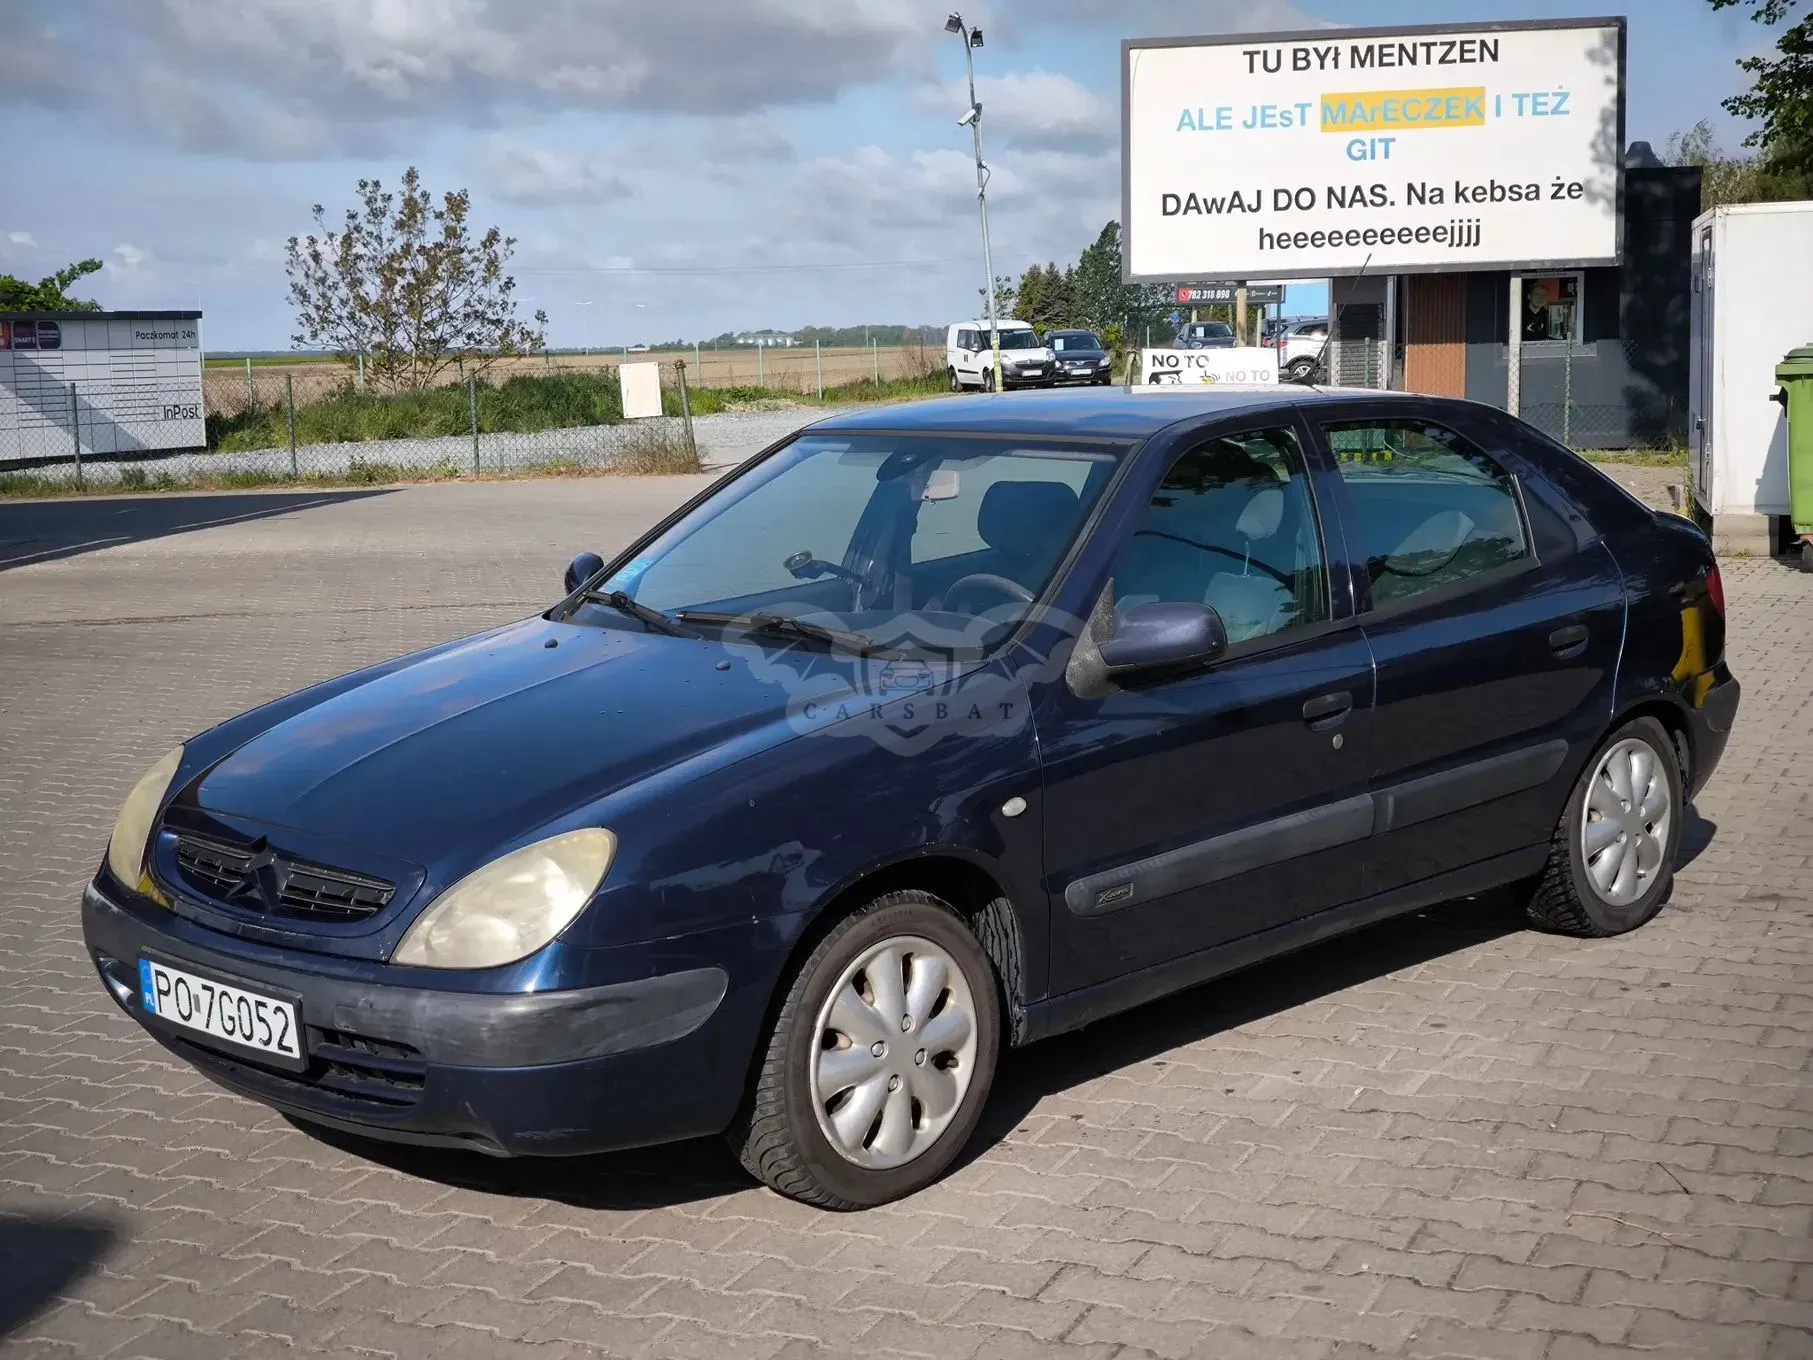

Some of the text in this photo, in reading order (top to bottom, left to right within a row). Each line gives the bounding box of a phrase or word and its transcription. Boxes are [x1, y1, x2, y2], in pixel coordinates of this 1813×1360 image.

[1242, 38, 1499, 74] TU BYł MENTZEN
[1176, 85, 1570, 132] ALE JEsT MArECZEK I TEŻ
[1346, 137, 1397, 162] GIT
[1161, 175, 1584, 217] DAwAJ DO NAS. Na kebsa że
[1258, 218, 1482, 251] heeeeeeeeeejjjj
[135, 330, 196, 340] Paczkomat 24h
[1152, 355, 1210, 368] NO TO
[1225, 369, 1270, 382] NO TO
[163, 403, 199, 420] InPost
[154, 969, 294, 1053] PO 7G052
